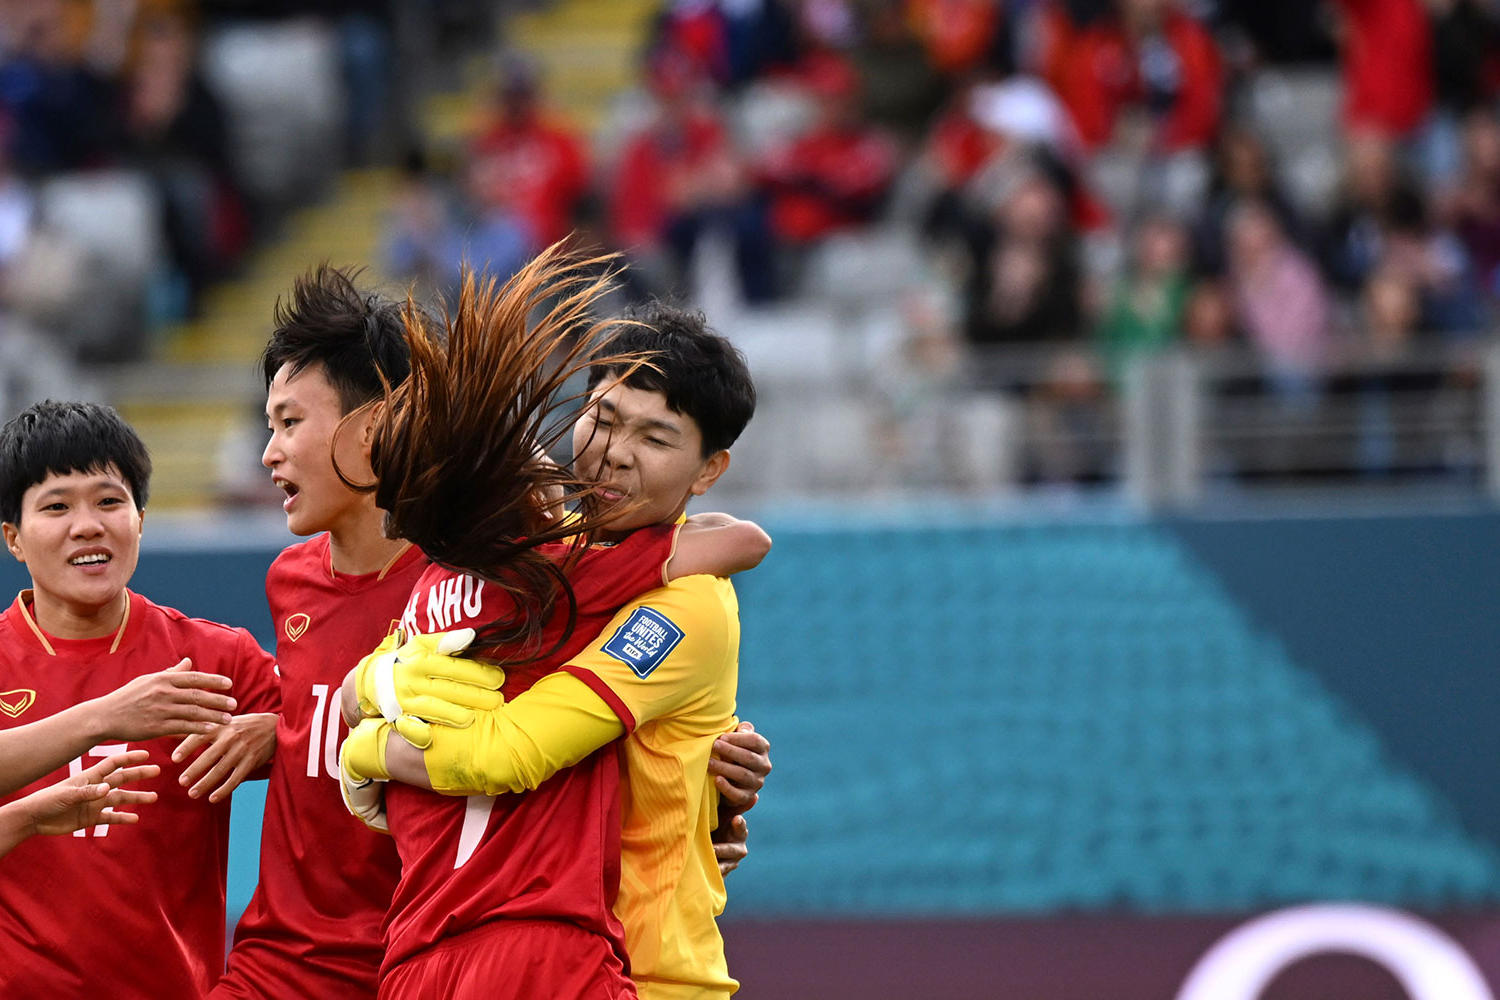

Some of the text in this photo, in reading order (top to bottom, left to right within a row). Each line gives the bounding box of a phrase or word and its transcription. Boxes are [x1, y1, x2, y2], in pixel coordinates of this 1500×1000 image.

[631, 622, 663, 649] UNITES
[638, 615, 668, 640] FOOTBALL
[623, 631, 658, 658] the World
[625, 646, 639, 658] FIFA
